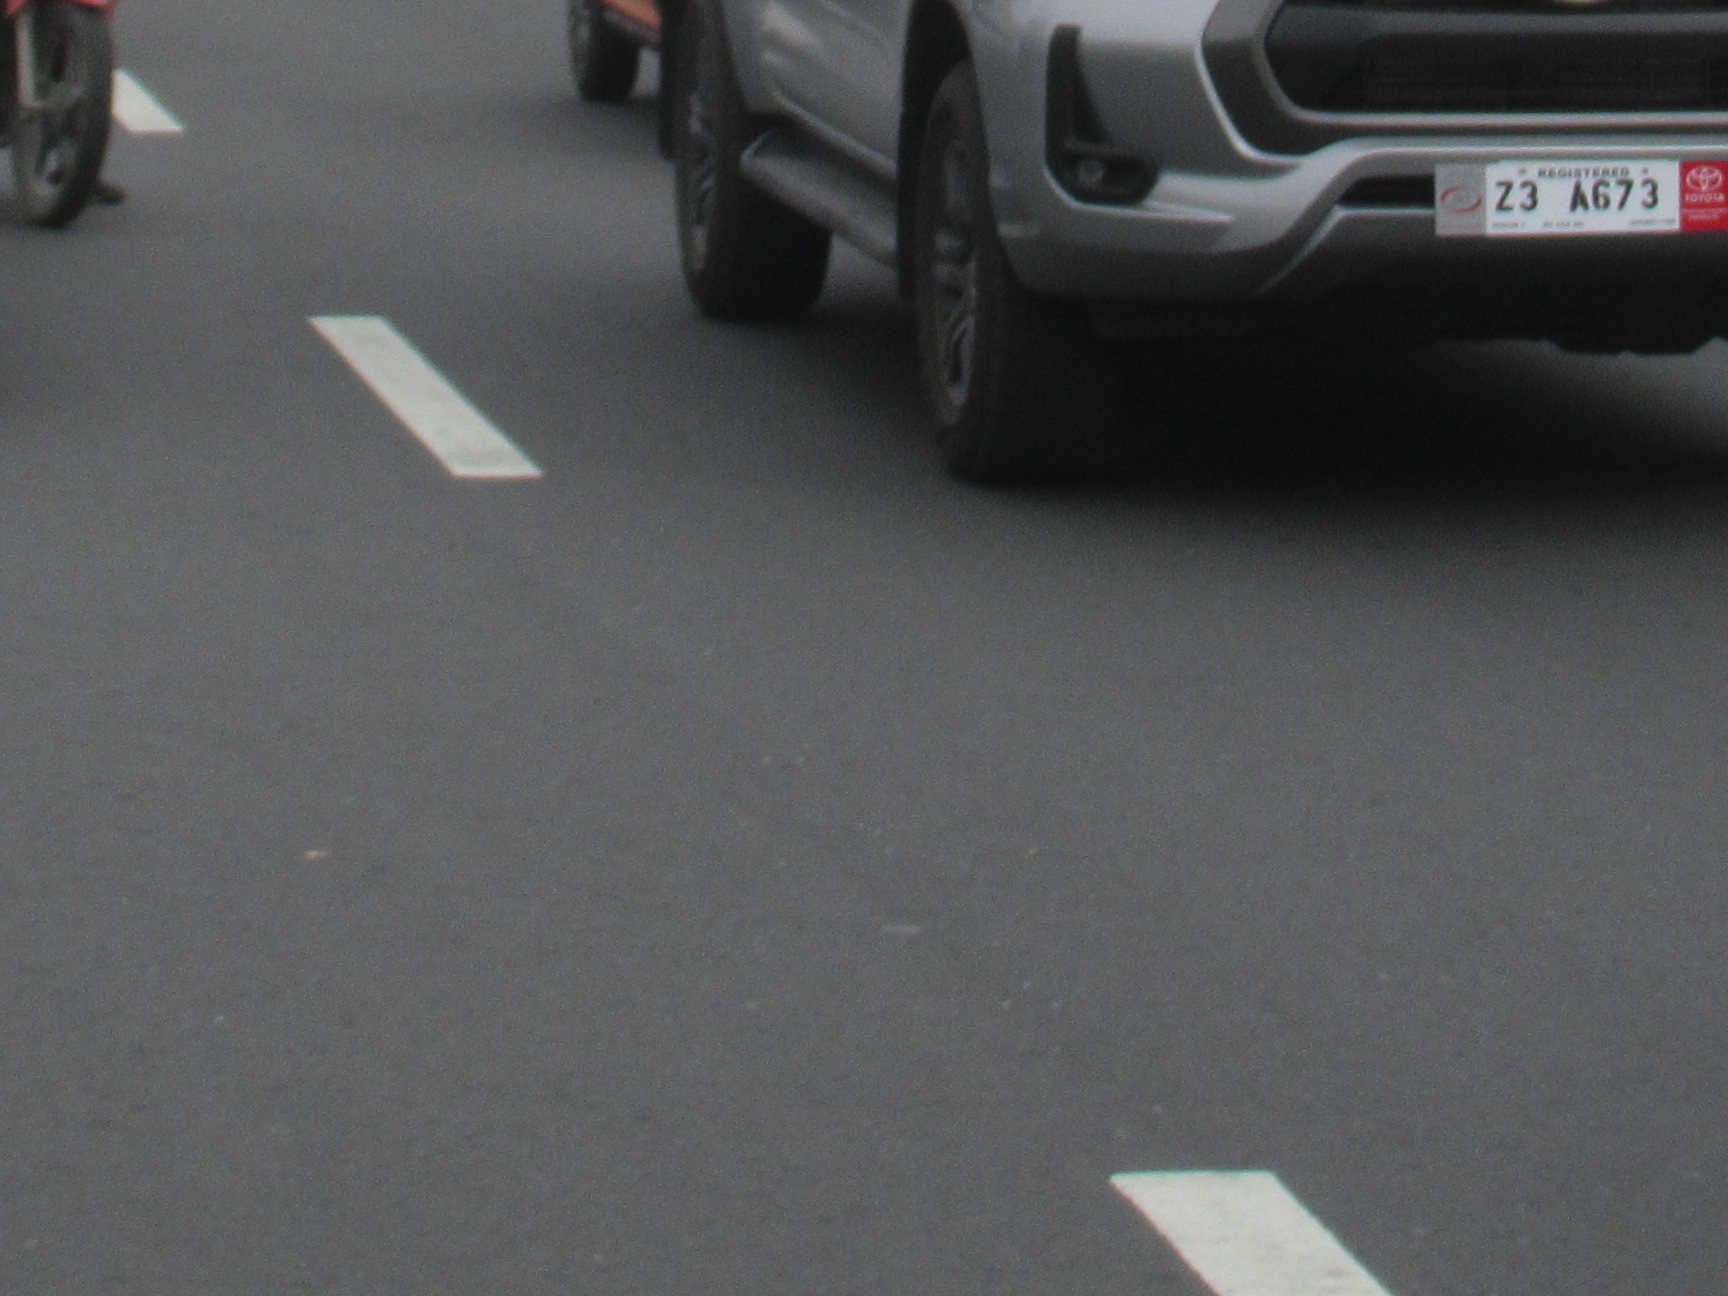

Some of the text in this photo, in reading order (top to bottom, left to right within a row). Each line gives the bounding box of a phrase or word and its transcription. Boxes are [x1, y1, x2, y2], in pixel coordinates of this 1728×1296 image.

[1537, 166, 1631, 179] REGISTERED
[1495, 177, 1660, 213] Z3 A673
[1684, 192, 1726, 204] TOYOTA
